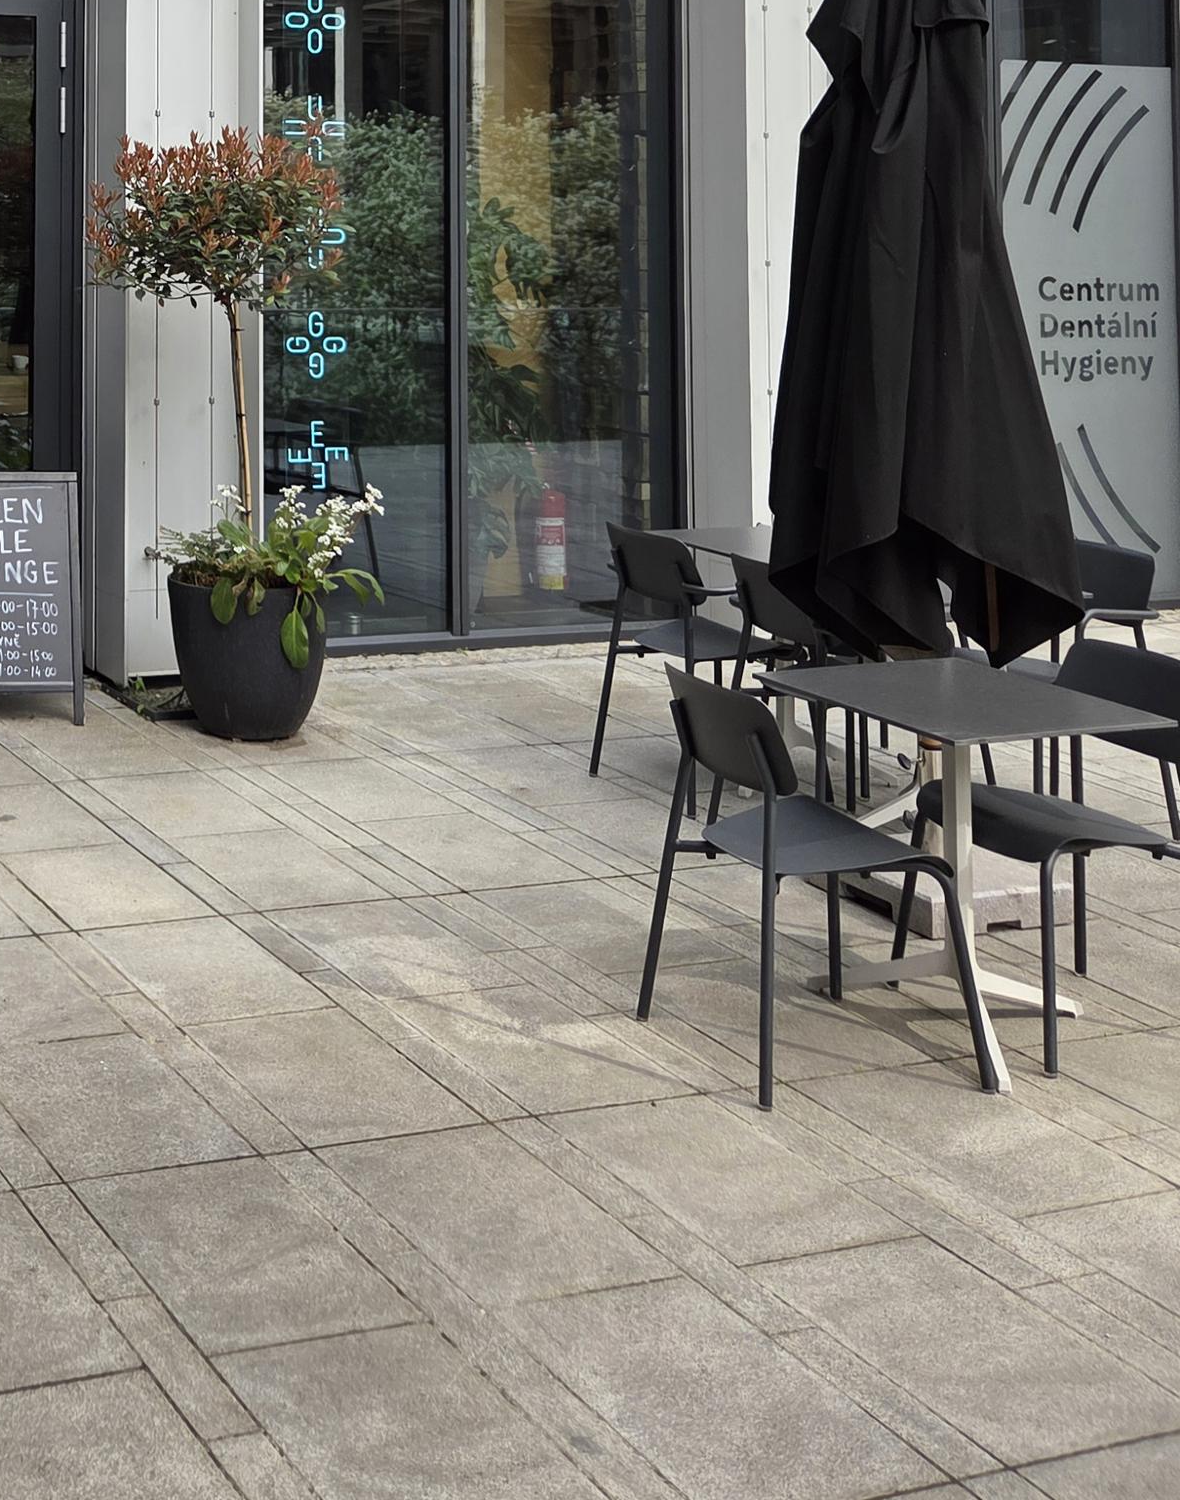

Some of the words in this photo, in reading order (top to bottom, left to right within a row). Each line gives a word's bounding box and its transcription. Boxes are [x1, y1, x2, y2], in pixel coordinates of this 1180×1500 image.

[1038, 276, 1160, 301] Centrum
[1040, 311, 1158, 338] Dentální
[1040, 348, 1154, 382] Hygieny
